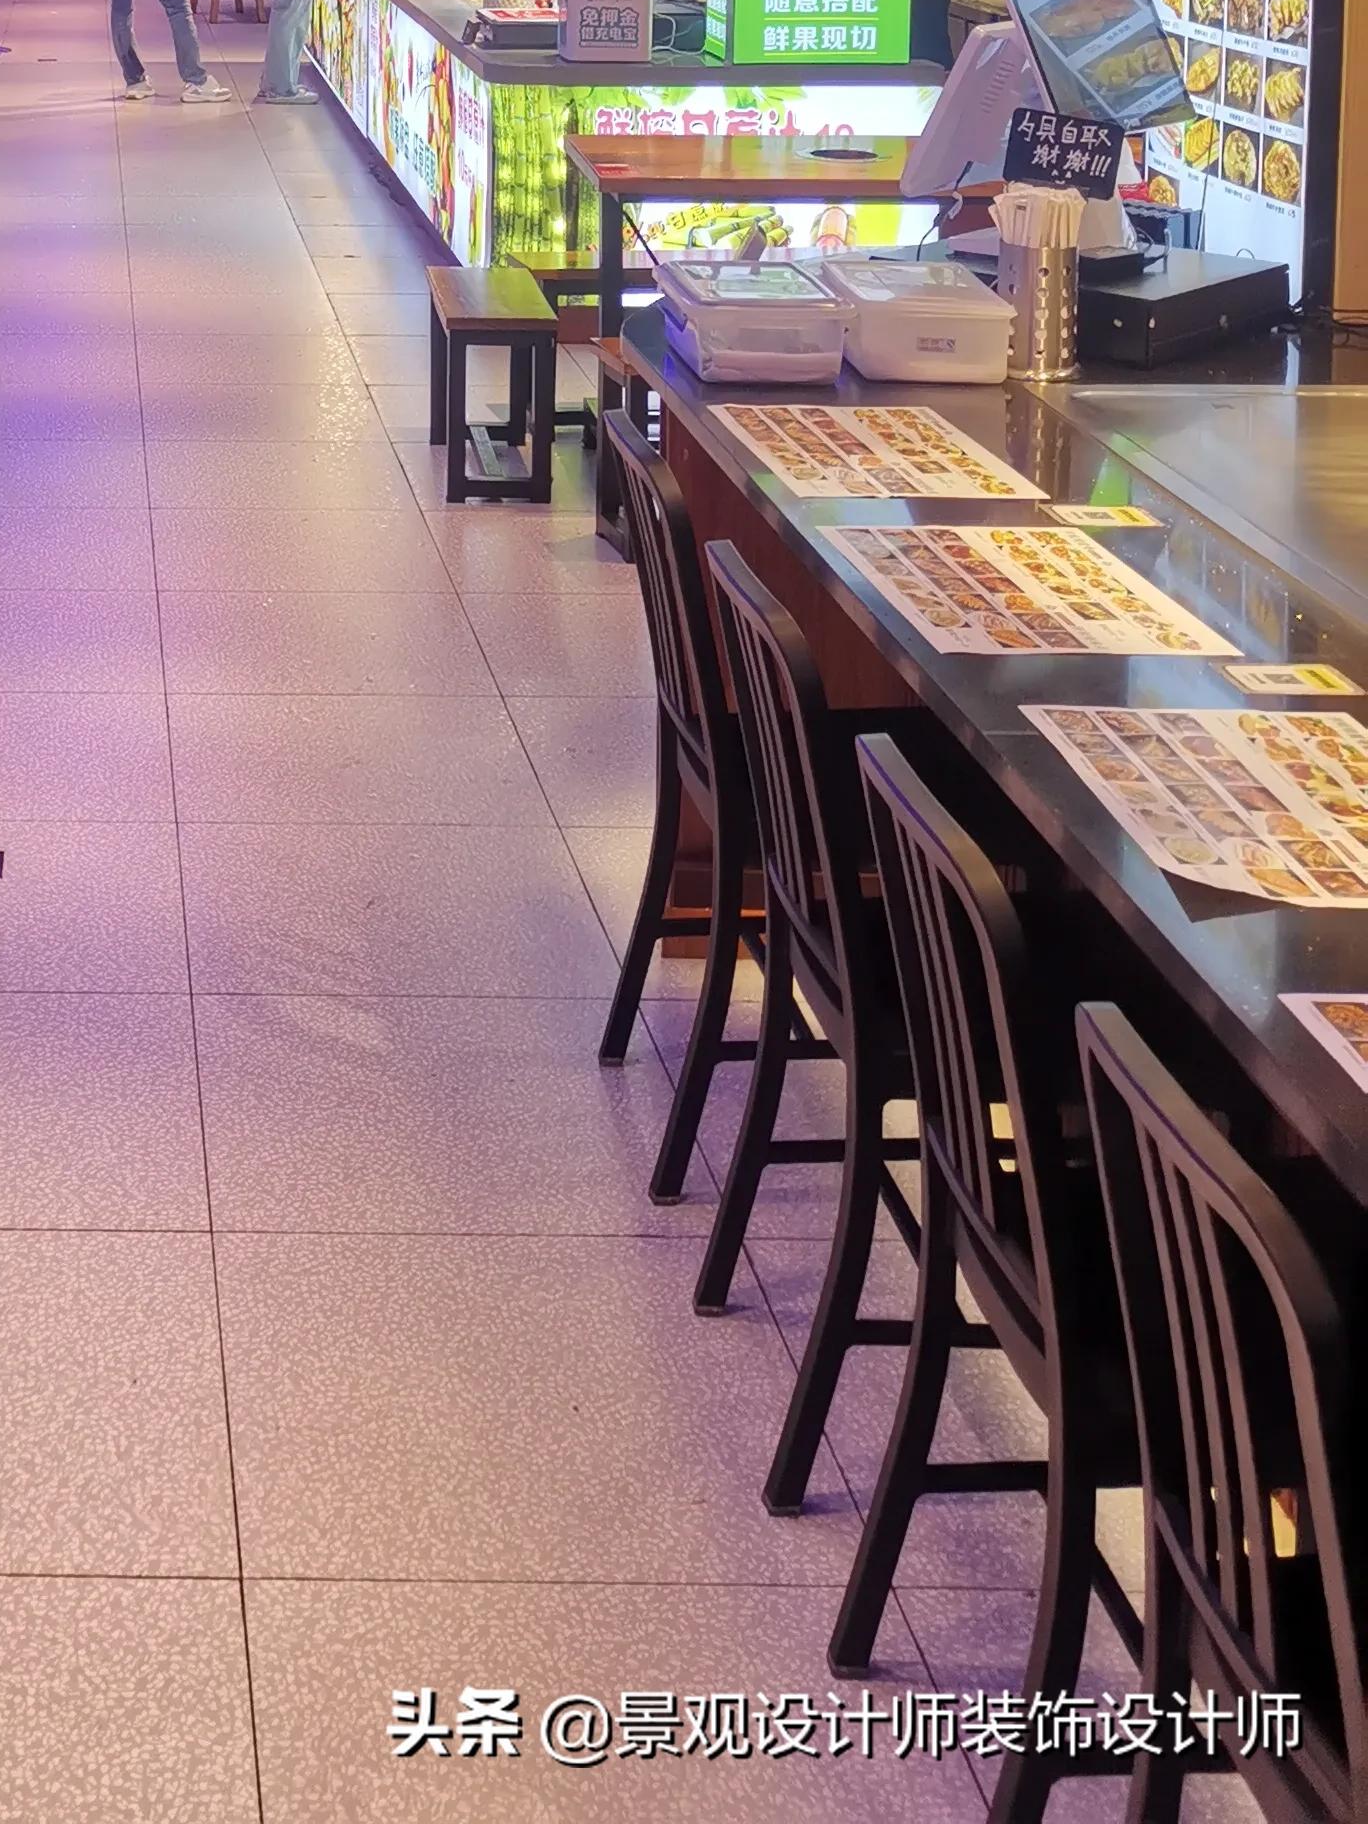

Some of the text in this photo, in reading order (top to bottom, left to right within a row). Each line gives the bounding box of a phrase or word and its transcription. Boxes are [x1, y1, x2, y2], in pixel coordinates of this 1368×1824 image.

[581, 7, 638, 27] 免押金
[581, 26, 638, 41] 借充电宝
[762, 25, 877, 53] 鲜果现切
